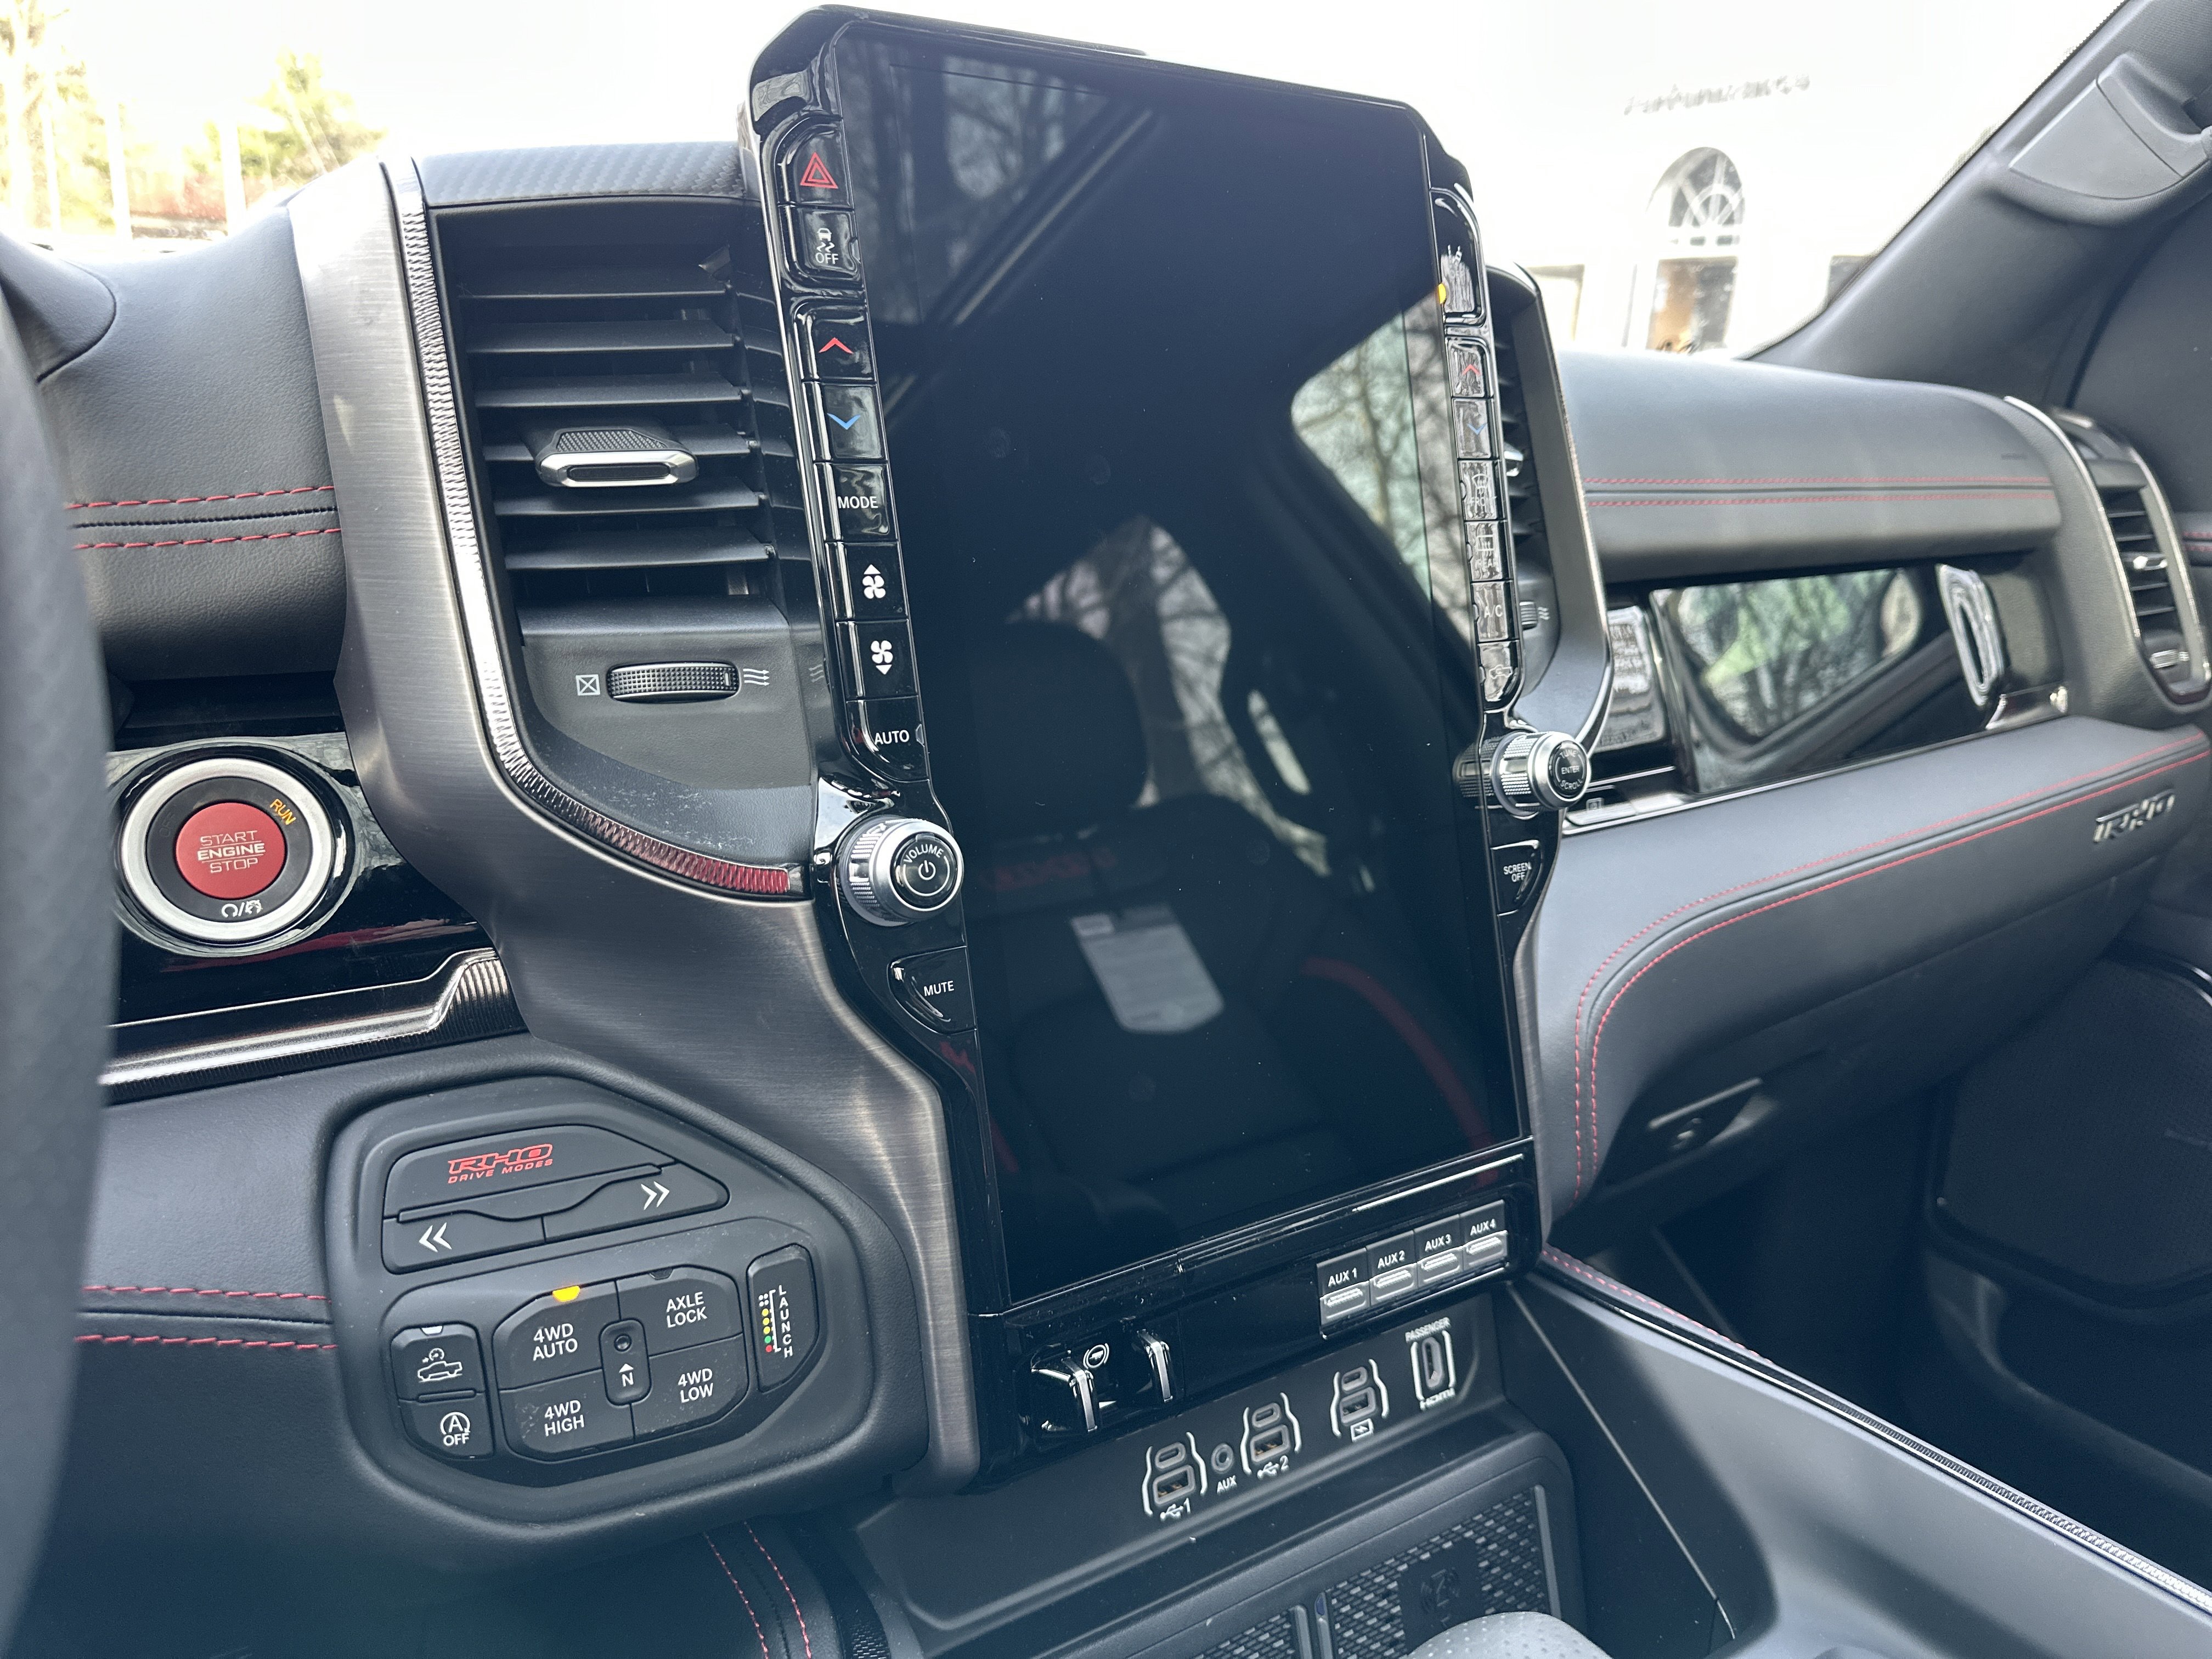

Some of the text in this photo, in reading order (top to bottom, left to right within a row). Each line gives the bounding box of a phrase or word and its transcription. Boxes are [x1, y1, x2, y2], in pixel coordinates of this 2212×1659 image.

[815, 252, 839, 266] OFF
[837, 495, 879, 509] MODE
[1470, 496, 1497, 507] FROT
[1483, 604, 1503, 618] A/C
[873, 729, 910, 745] AUTO
[1561, 765, 1580, 775] ENTER
[1560, 779, 1584, 791] SCROLL
[269, 798, 297, 826] RUN
[200, 830, 258, 846] START
[197, 842, 266, 861] ENGINE
[902, 844, 945, 865] VOLUME
[210, 857, 259, 874] STOP
[1503, 861, 1531, 876] SCREEN
[1511, 872, 1525, 883] OFF
[923, 981, 955, 996] MUTE
[447, 1144, 553, 1174] RHO
[448, 1158, 553, 1183] DRIVE MODES
[1470, 1221, 1488, 1235] AUX
[1425, 1234, 1452, 1251] AUX 3
[1377, 1251, 1405, 1268] AUX 2
[1328, 1268, 1357, 1286] AUX 1
[666, 1292, 704, 1312] AXLE
[667, 1307, 707, 1328] LOCK
[533, 1324, 574, 1343] 4WD
[1405, 1317, 1451, 1342] PASSENGER
[533, 1339, 578, 1361] AUTO
[622, 1373, 634, 1386] N
[678, 1368, 713, 1387] 4WD
[680, 1383, 713, 1403] LOW
[544, 1401, 581, 1420] 4WD
[544, 1417, 585, 1436] HIGH
[443, 1434, 470, 1446] OFF
[1280, 1456, 1289, 1470] 2
[1216, 1475, 1237, 1493] AUX
